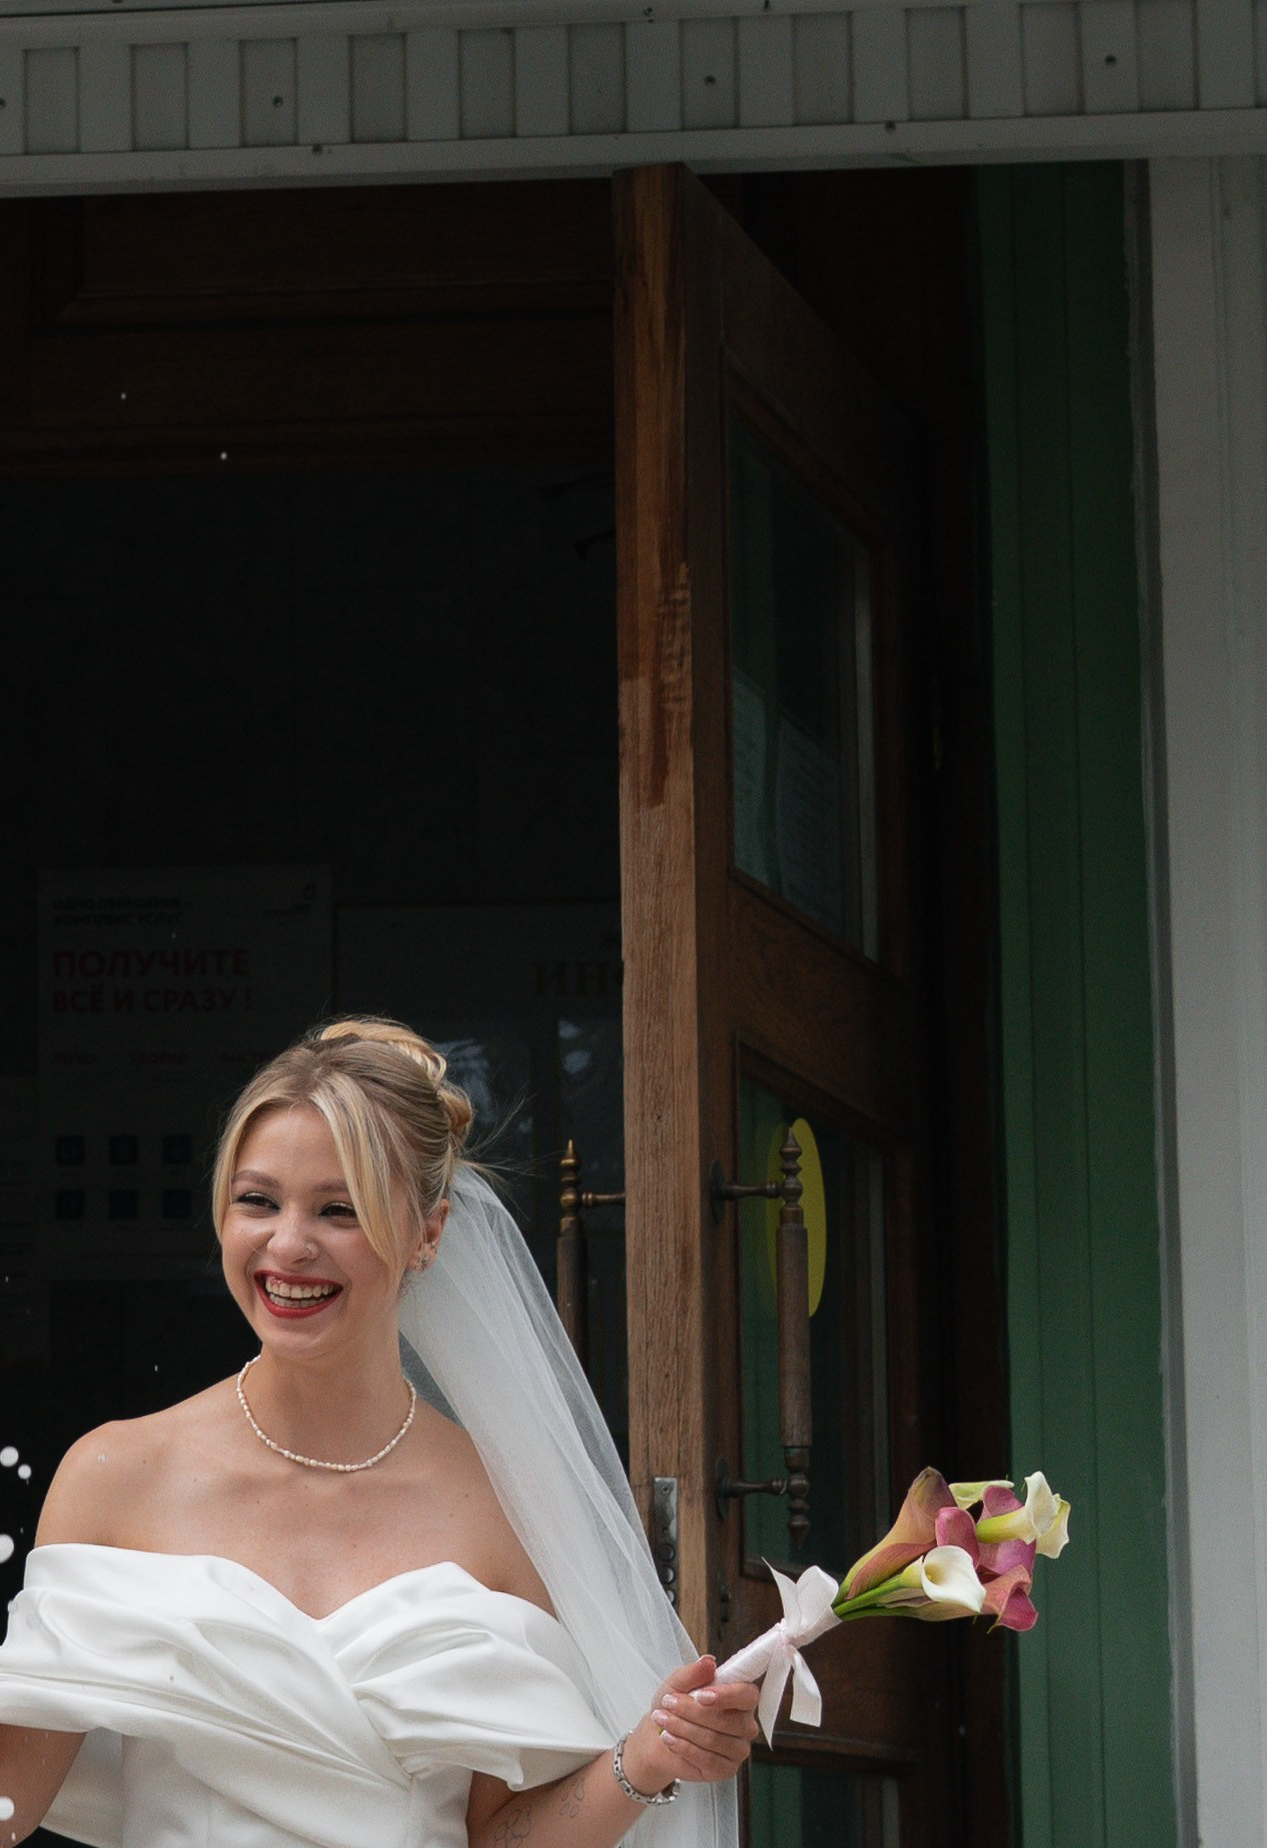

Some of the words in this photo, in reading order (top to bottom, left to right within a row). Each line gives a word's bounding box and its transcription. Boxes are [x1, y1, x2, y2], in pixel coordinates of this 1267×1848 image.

[53, 949, 251, 978] ПОЛУЧИТЕ
[534, 960, 622, 997] ИН
[52, 983, 104, 1014] ВСЁ
[113, 988, 133, 1013] И
